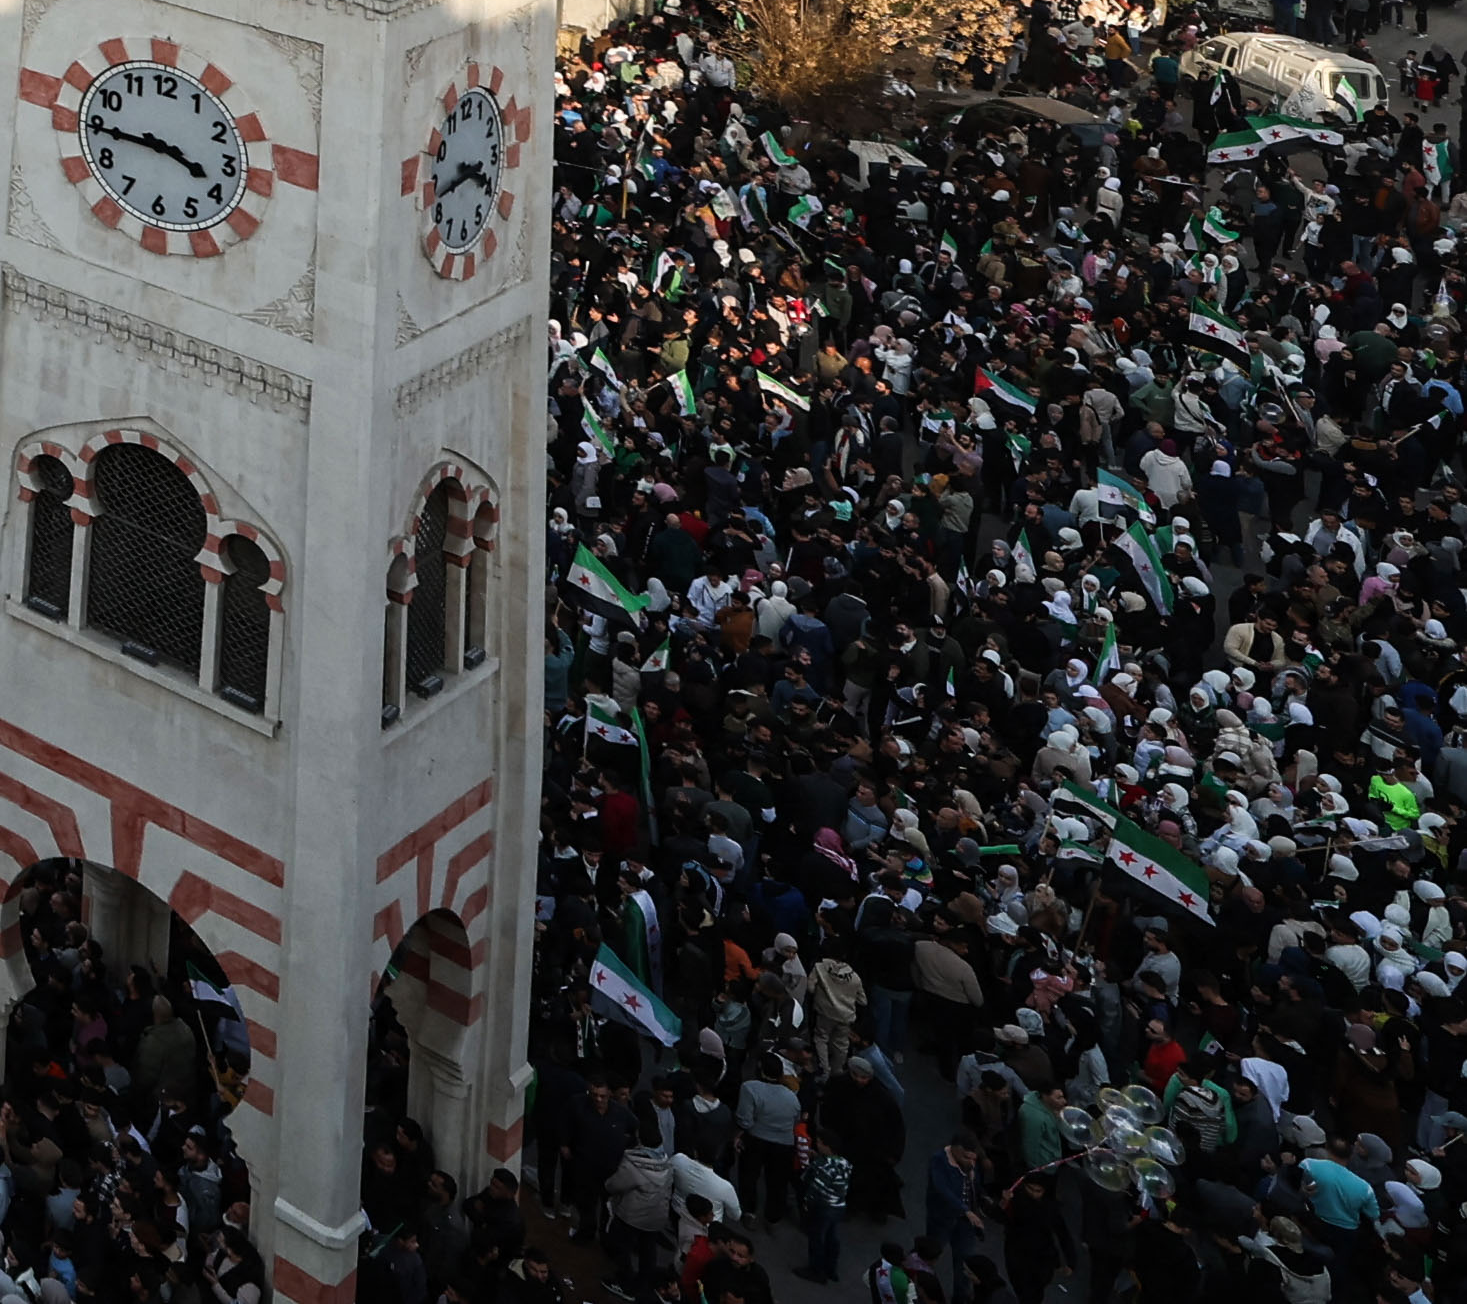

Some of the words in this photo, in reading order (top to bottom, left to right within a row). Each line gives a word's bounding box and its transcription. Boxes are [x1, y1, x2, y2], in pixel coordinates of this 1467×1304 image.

[124, 73, 143, 97] 11
[153, 74, 178, 99] 12
[100, 89, 122, 112] 10
[191, 93, 201, 114] 1
[460, 97, 473, 121] 12
[477, 100, 483, 120] 1
[211, 121, 227, 143] 2
[447, 111, 457, 135] 11
[486, 117, 494, 138] 2
[99, 148, 114, 169] 8
[490, 144, 498, 165] 3
[221, 154, 237, 177] 3
[121, 175, 136, 196] 7
[207, 183, 224, 204] 4
[151, 195, 166, 215] 6
[183, 197, 199, 219] 5
[435, 202, 443, 224] 8
[475, 204, 482, 225] 5
[446, 218, 454, 240] 7
[460, 220, 468, 240] 6
